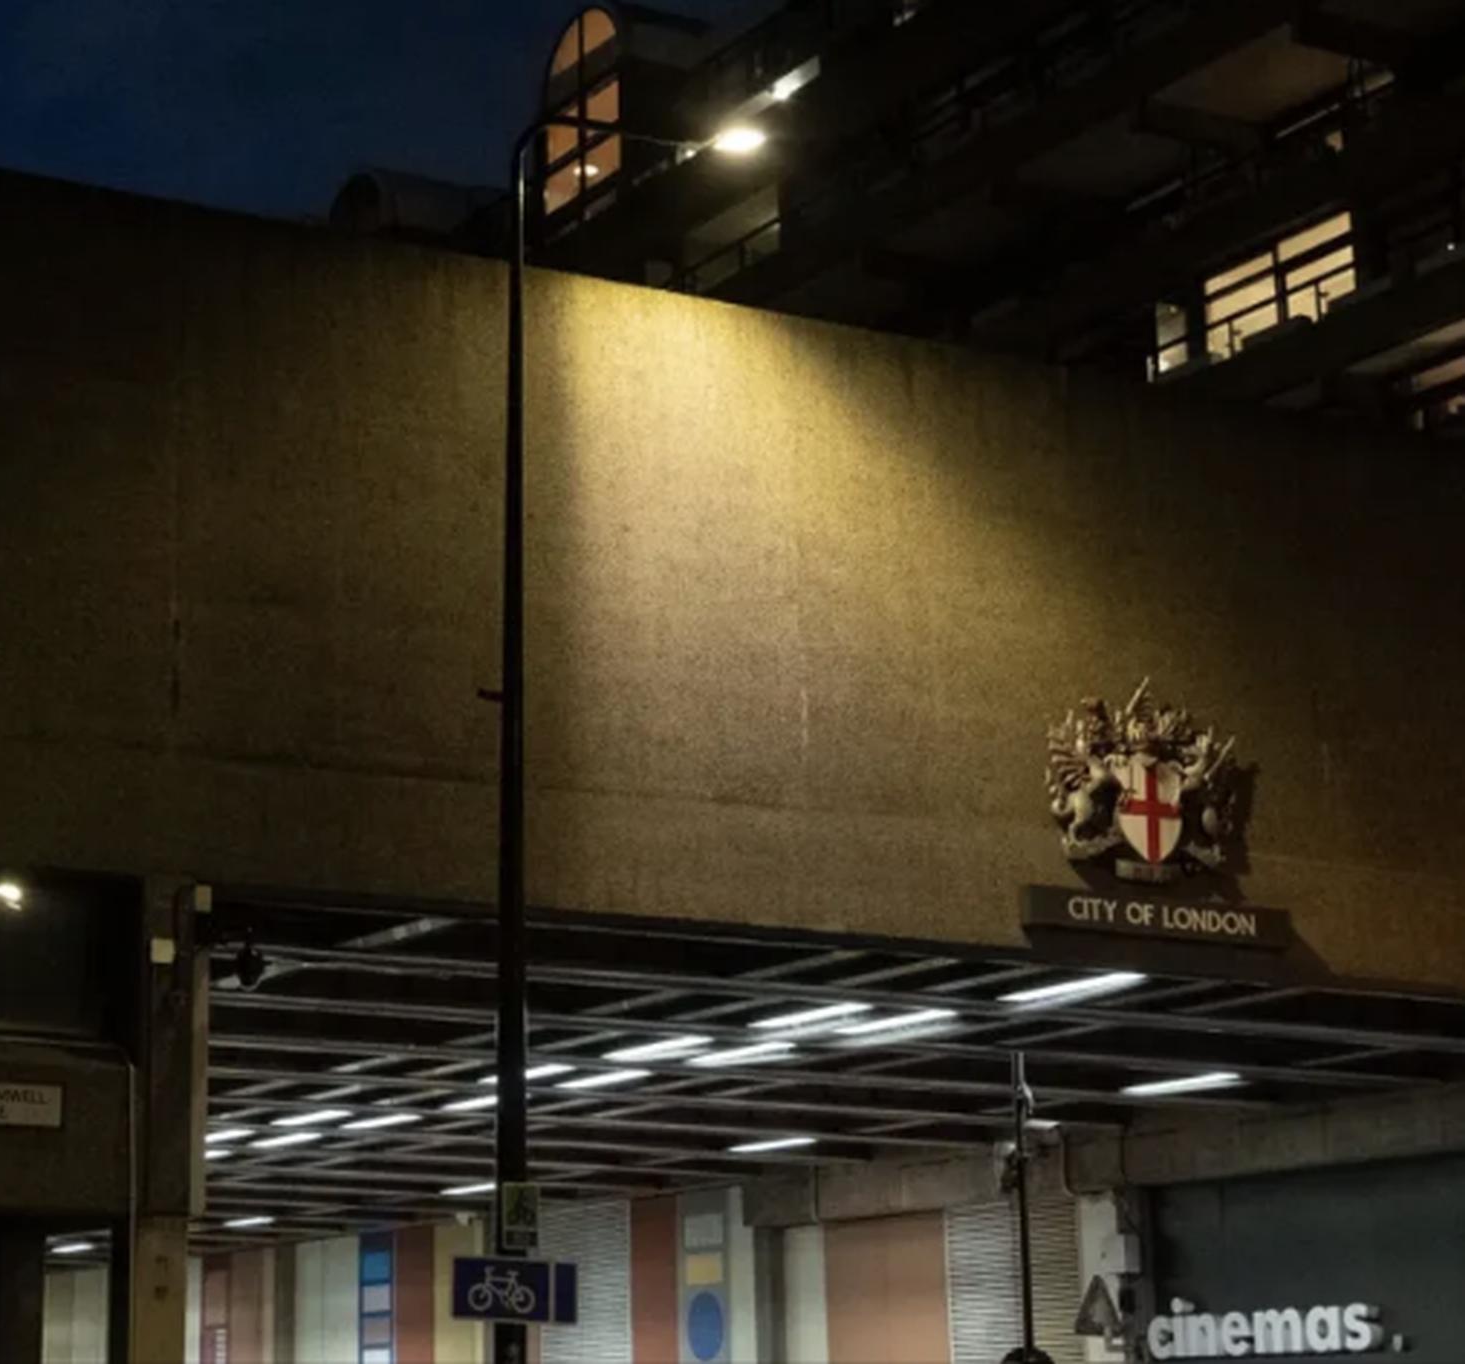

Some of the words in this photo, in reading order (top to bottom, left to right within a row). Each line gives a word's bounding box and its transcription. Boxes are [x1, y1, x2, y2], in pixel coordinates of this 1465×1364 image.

[1067, 896, 1118, 924] CITY
[1125, 901, 1155, 926] OF
[1162, 905, 1257, 936] LONDON
